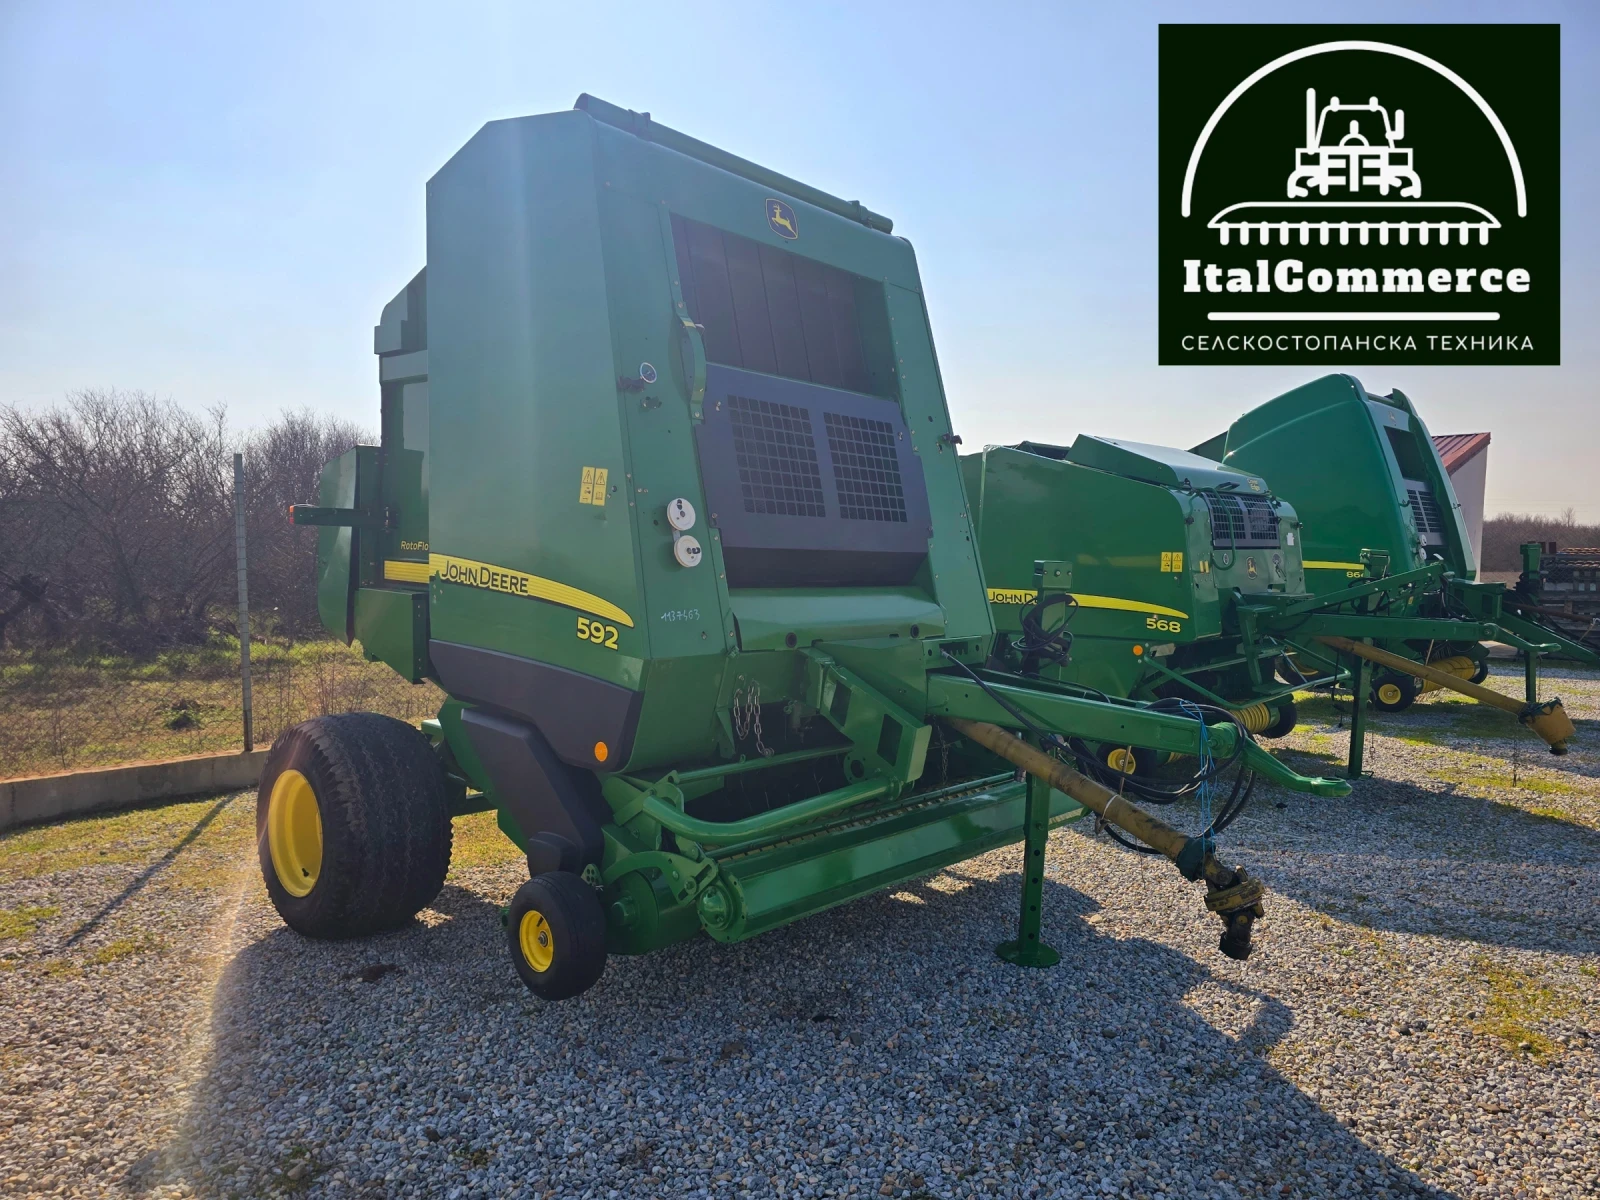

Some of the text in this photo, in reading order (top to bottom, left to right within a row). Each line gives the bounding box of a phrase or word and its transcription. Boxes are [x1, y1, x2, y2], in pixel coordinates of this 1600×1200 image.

[441, 560, 529, 593] JOHN DEERE
[988, 591, 1022, 603] JOHN
[577, 616, 619, 651] 592
[1146, 617, 1181, 633] 568
